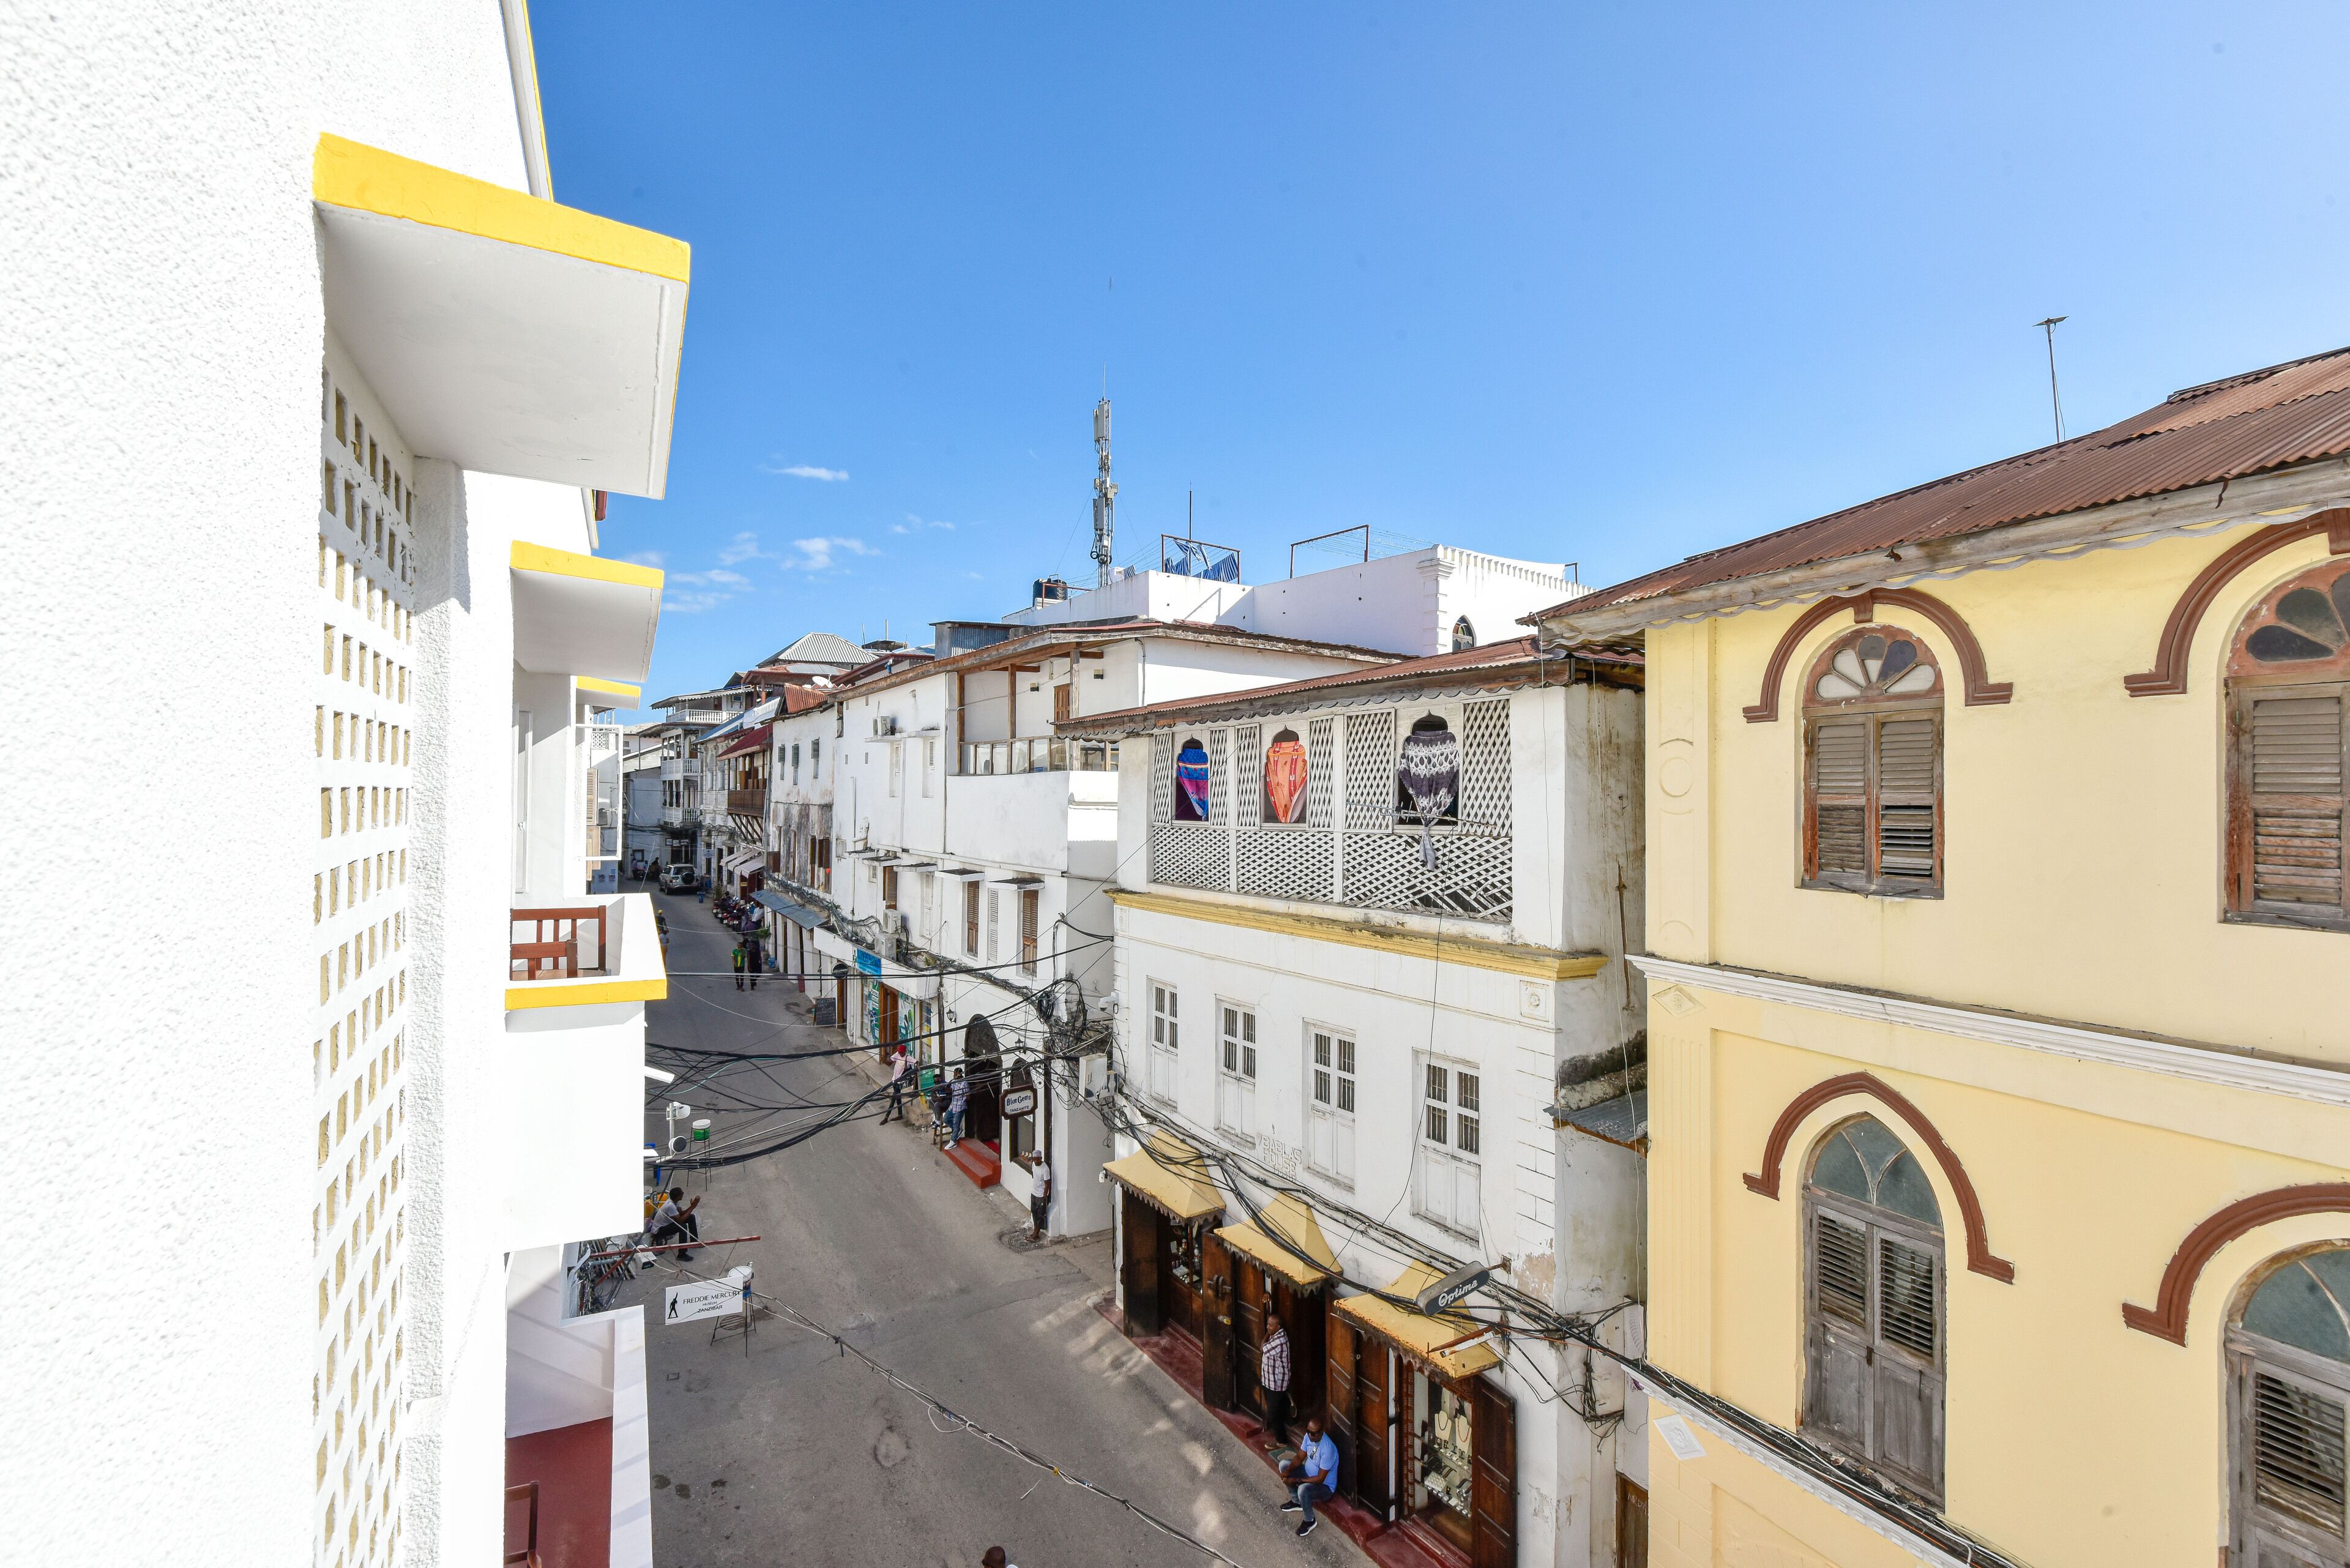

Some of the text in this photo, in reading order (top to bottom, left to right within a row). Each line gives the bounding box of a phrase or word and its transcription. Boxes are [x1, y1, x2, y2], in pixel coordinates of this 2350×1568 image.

[1263, 1148, 1297, 1174] HOUSE
[683, 1290, 740, 1305] FREDDIE MERCURY
[1438, 1280, 1478, 1307] Optima
[698, 1305, 723, 1313] ZANZIBAR
